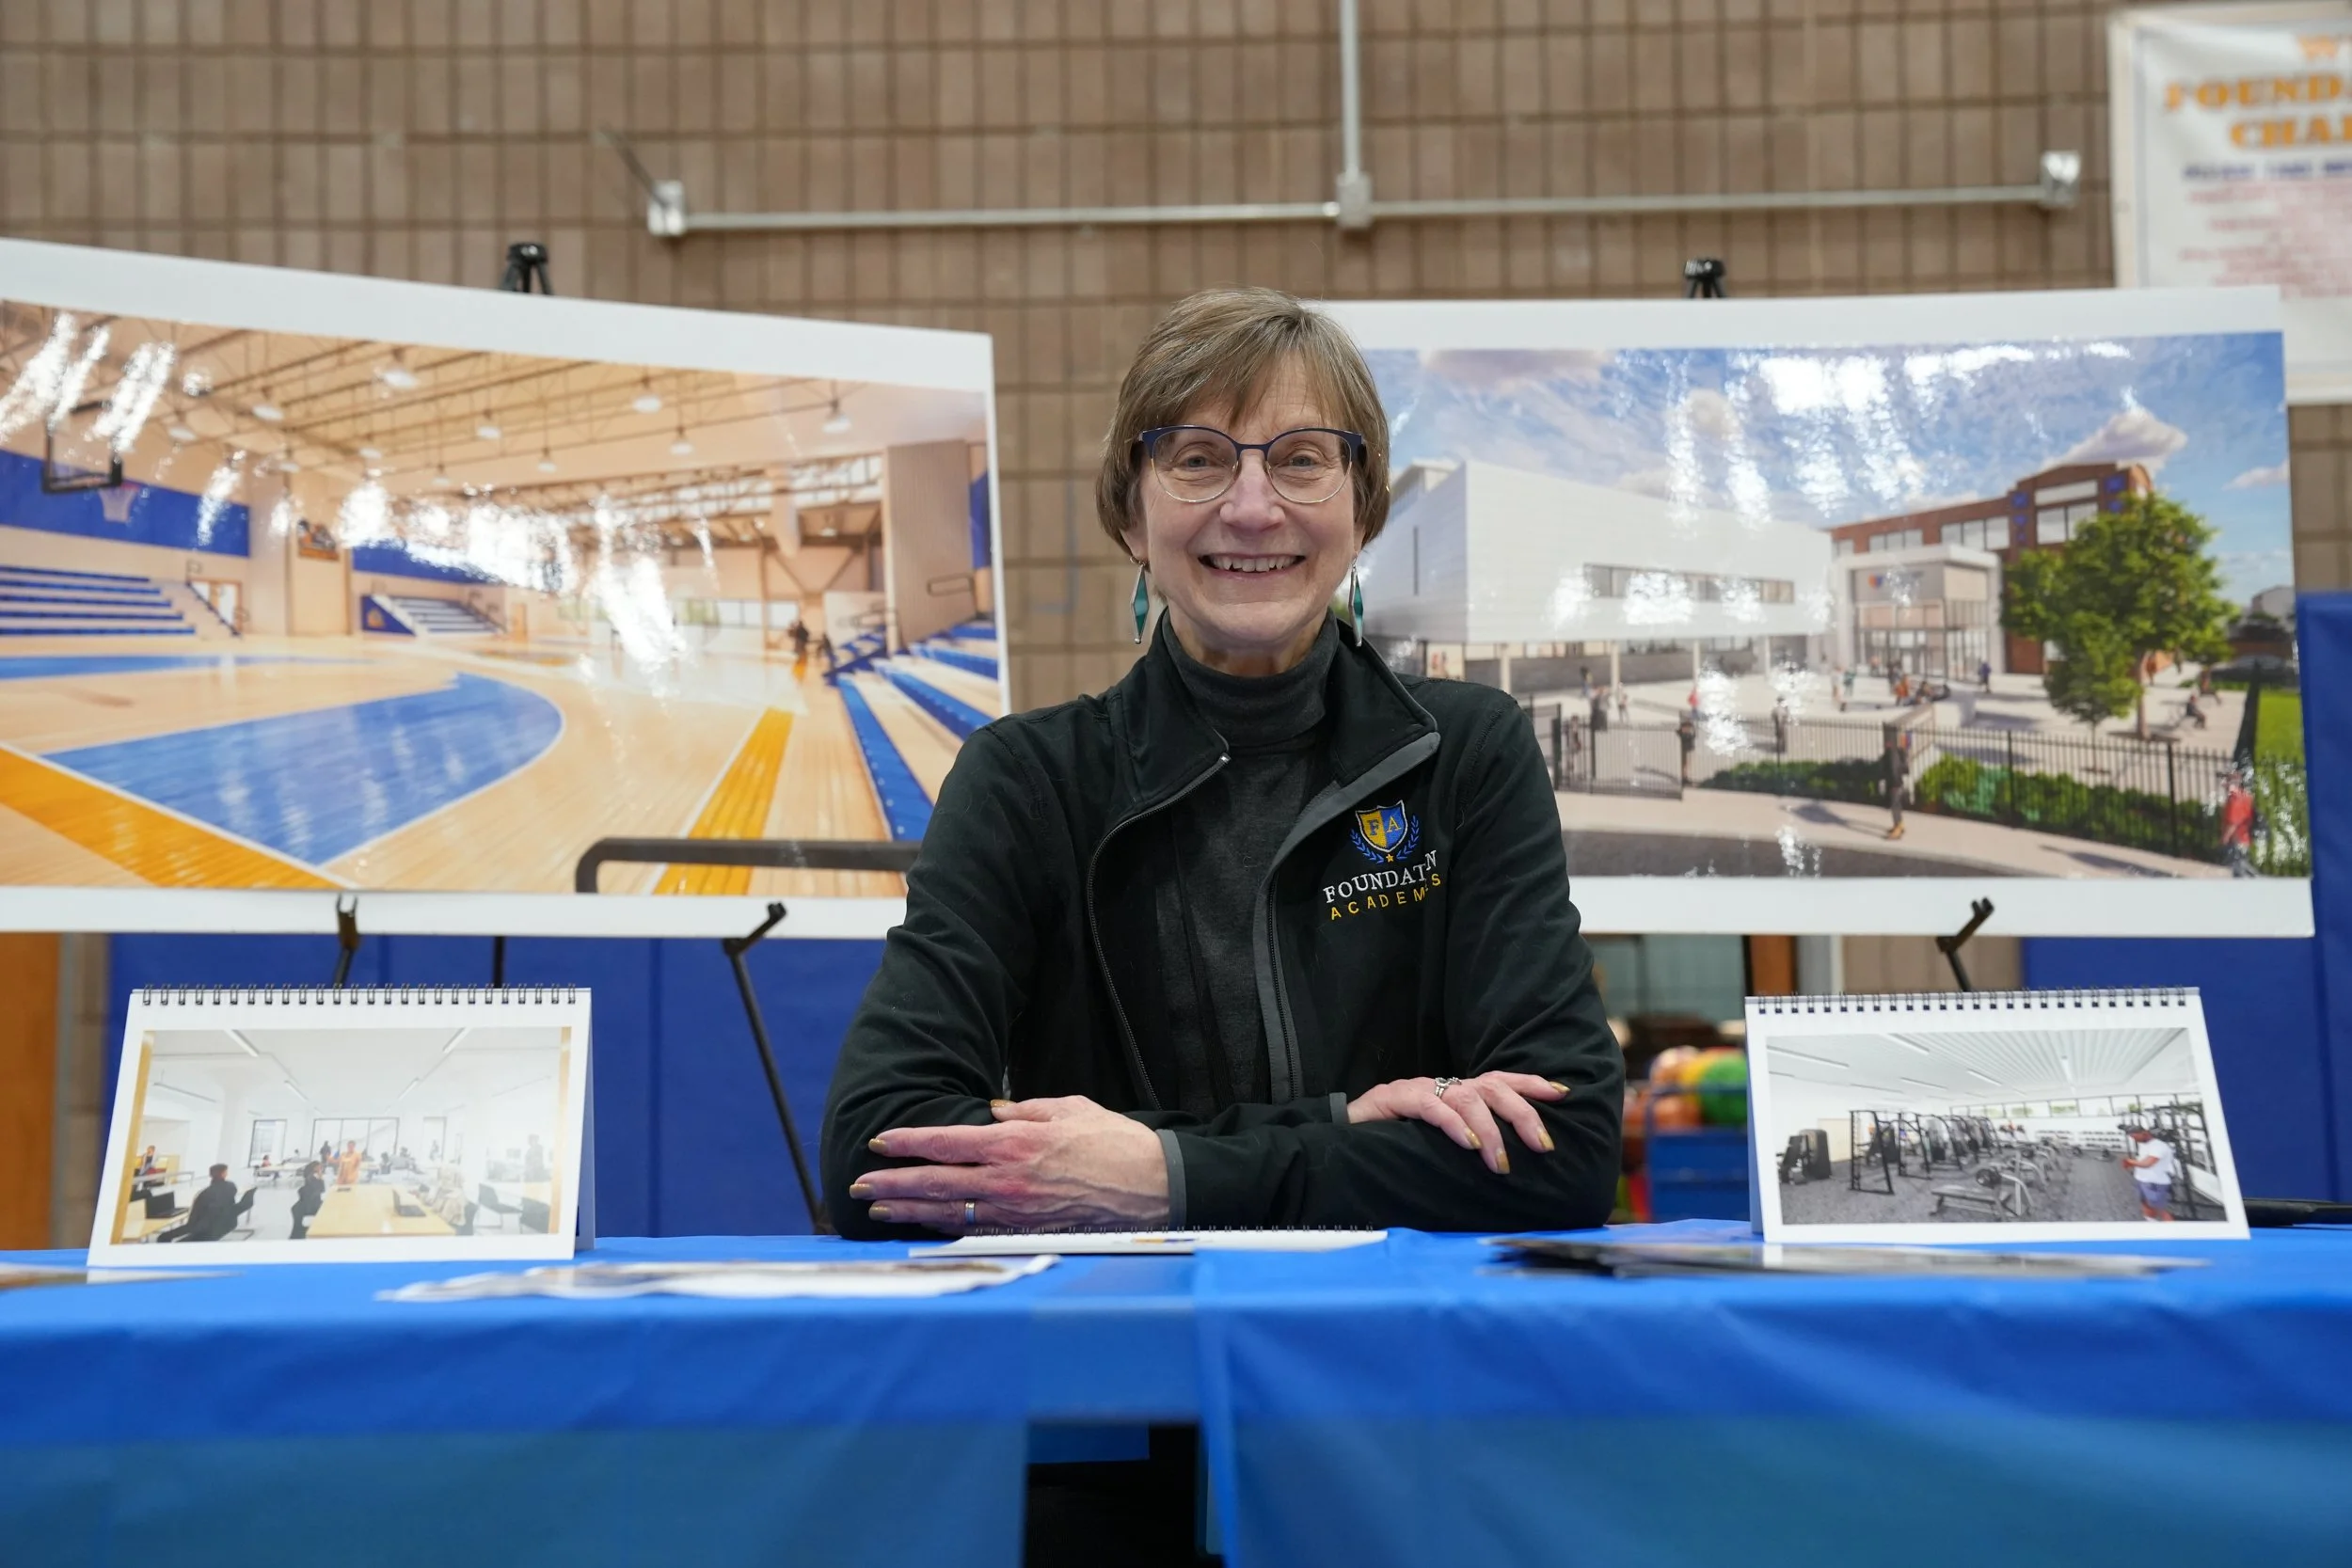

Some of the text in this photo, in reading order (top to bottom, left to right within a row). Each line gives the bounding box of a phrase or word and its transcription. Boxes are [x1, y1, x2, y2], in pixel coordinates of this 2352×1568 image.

[2166, 72, 2352, 112] FOUND
[1323, 850, 1437, 904] FOUNDATN
[1330, 873, 1441, 921] ACADEMS
